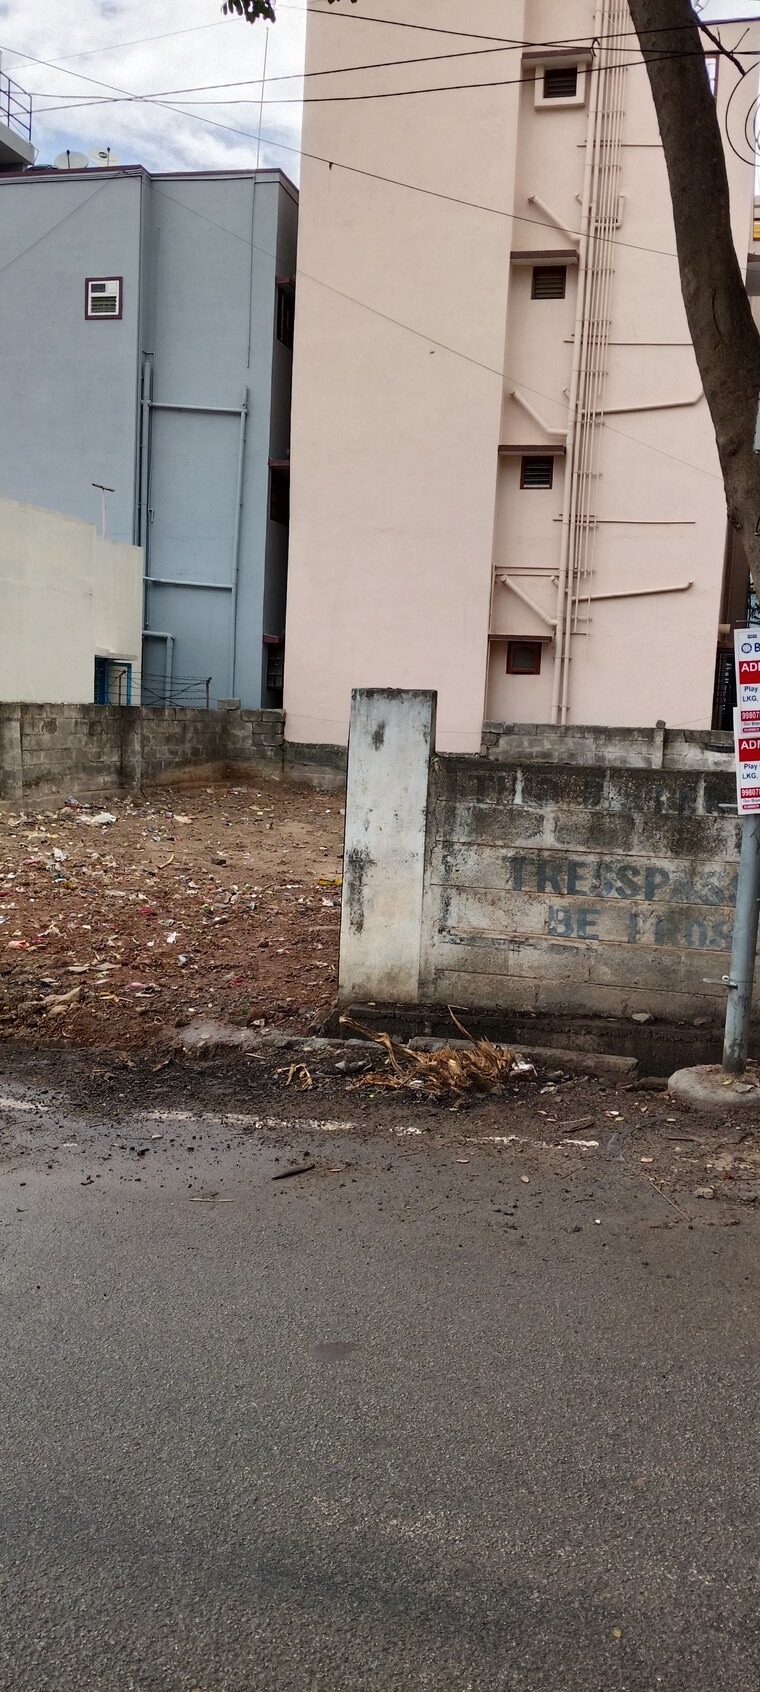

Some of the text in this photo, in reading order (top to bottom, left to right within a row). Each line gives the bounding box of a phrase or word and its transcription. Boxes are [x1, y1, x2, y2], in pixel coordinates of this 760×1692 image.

[744, 685, 758, 693] Play
[742, 711, 760, 719] 99807
[549, 904, 600, 941] BE
